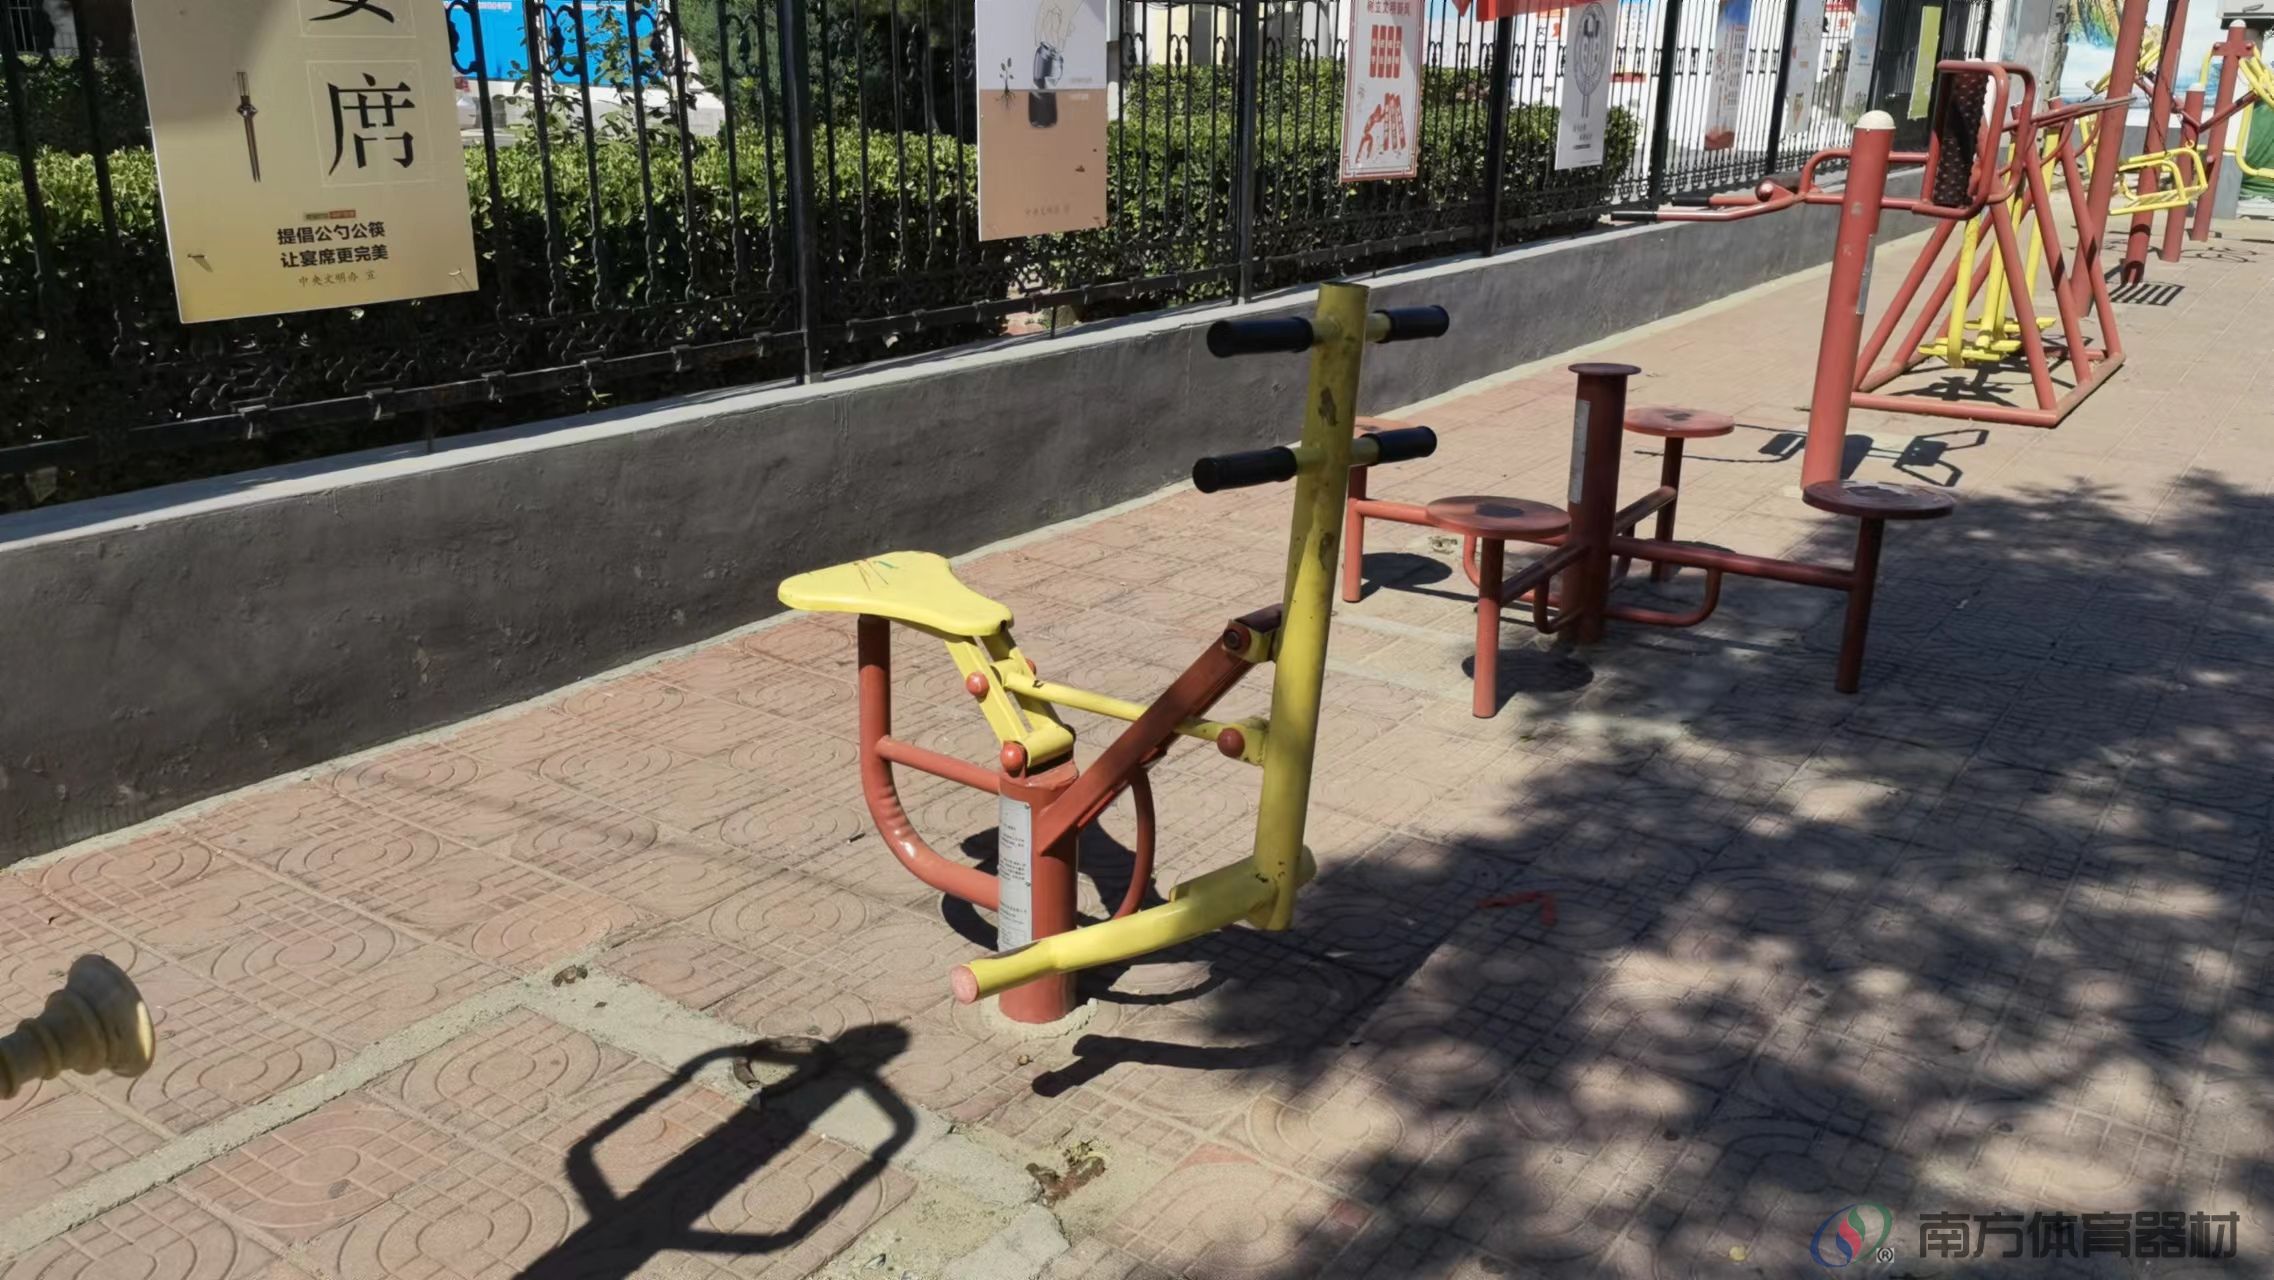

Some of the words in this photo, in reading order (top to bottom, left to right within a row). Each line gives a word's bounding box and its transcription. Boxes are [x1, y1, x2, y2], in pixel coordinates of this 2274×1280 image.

[277, 221, 386, 245] 提倡公勺公筷
[280, 244, 389, 268] 让宴席更完美
